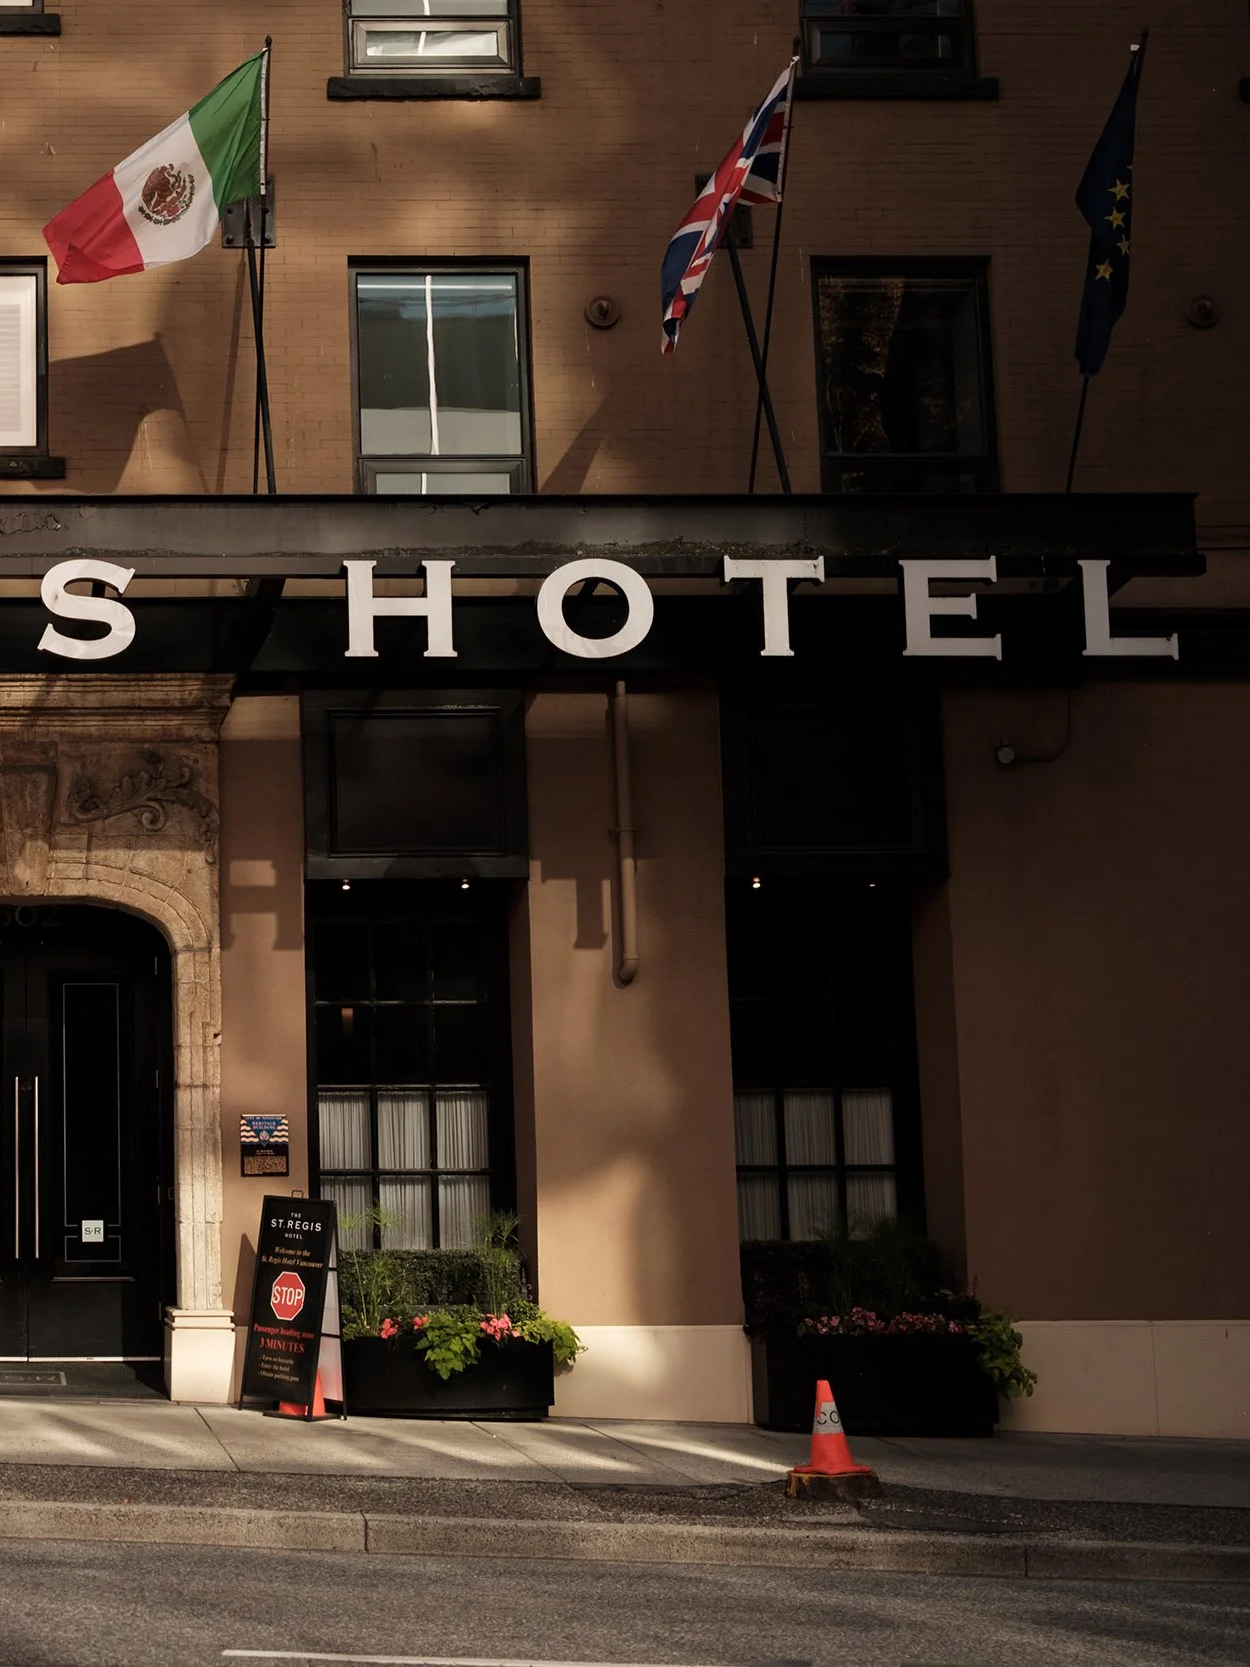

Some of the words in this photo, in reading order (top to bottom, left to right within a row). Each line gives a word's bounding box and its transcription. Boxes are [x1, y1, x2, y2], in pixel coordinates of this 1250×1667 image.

[343, 555, 1180, 661] HOTEL
[275, 1246, 295, 1255] Welcome
[268, 1256, 281, 1265] Regis
[282, 1257, 296, 1266] Hotel
[296, 1258, 323, 1268] Vancouver
[273, 1285, 303, 1306] STOP
[254, 1323, 280, 1336] Passenger
[280, 1327, 301, 1338] loading
[259, 1337, 265, 1348] 3
[266, 1339, 305, 1353] MINUTES
